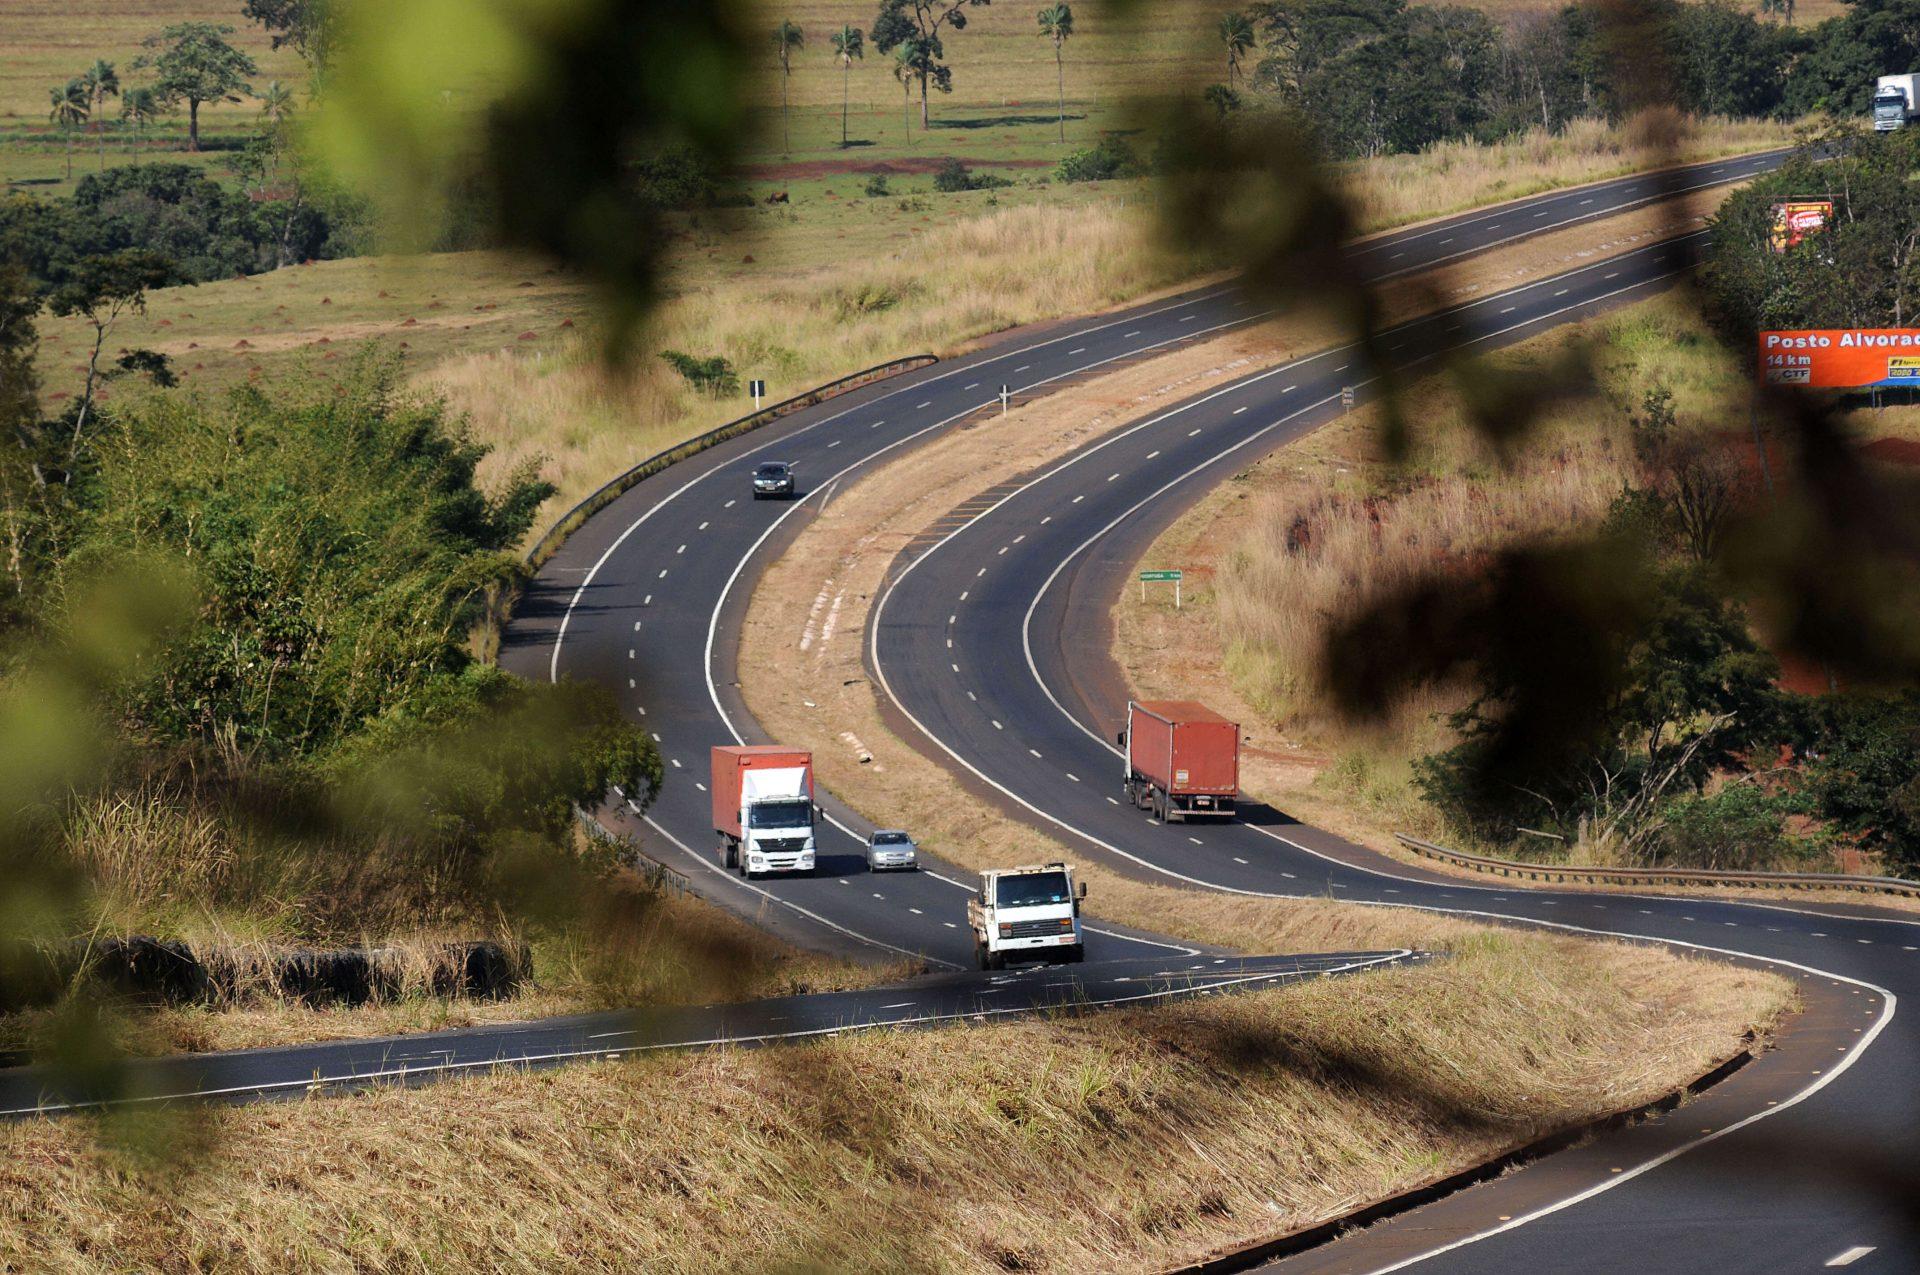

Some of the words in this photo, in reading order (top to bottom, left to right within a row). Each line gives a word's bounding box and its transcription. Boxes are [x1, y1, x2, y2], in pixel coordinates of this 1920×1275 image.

[1767, 334, 1831, 348] Posto
[1767, 354, 1783, 366] 14
[1787, 354, 1811, 365] km
[1782, 369, 1809, 378] CTF
